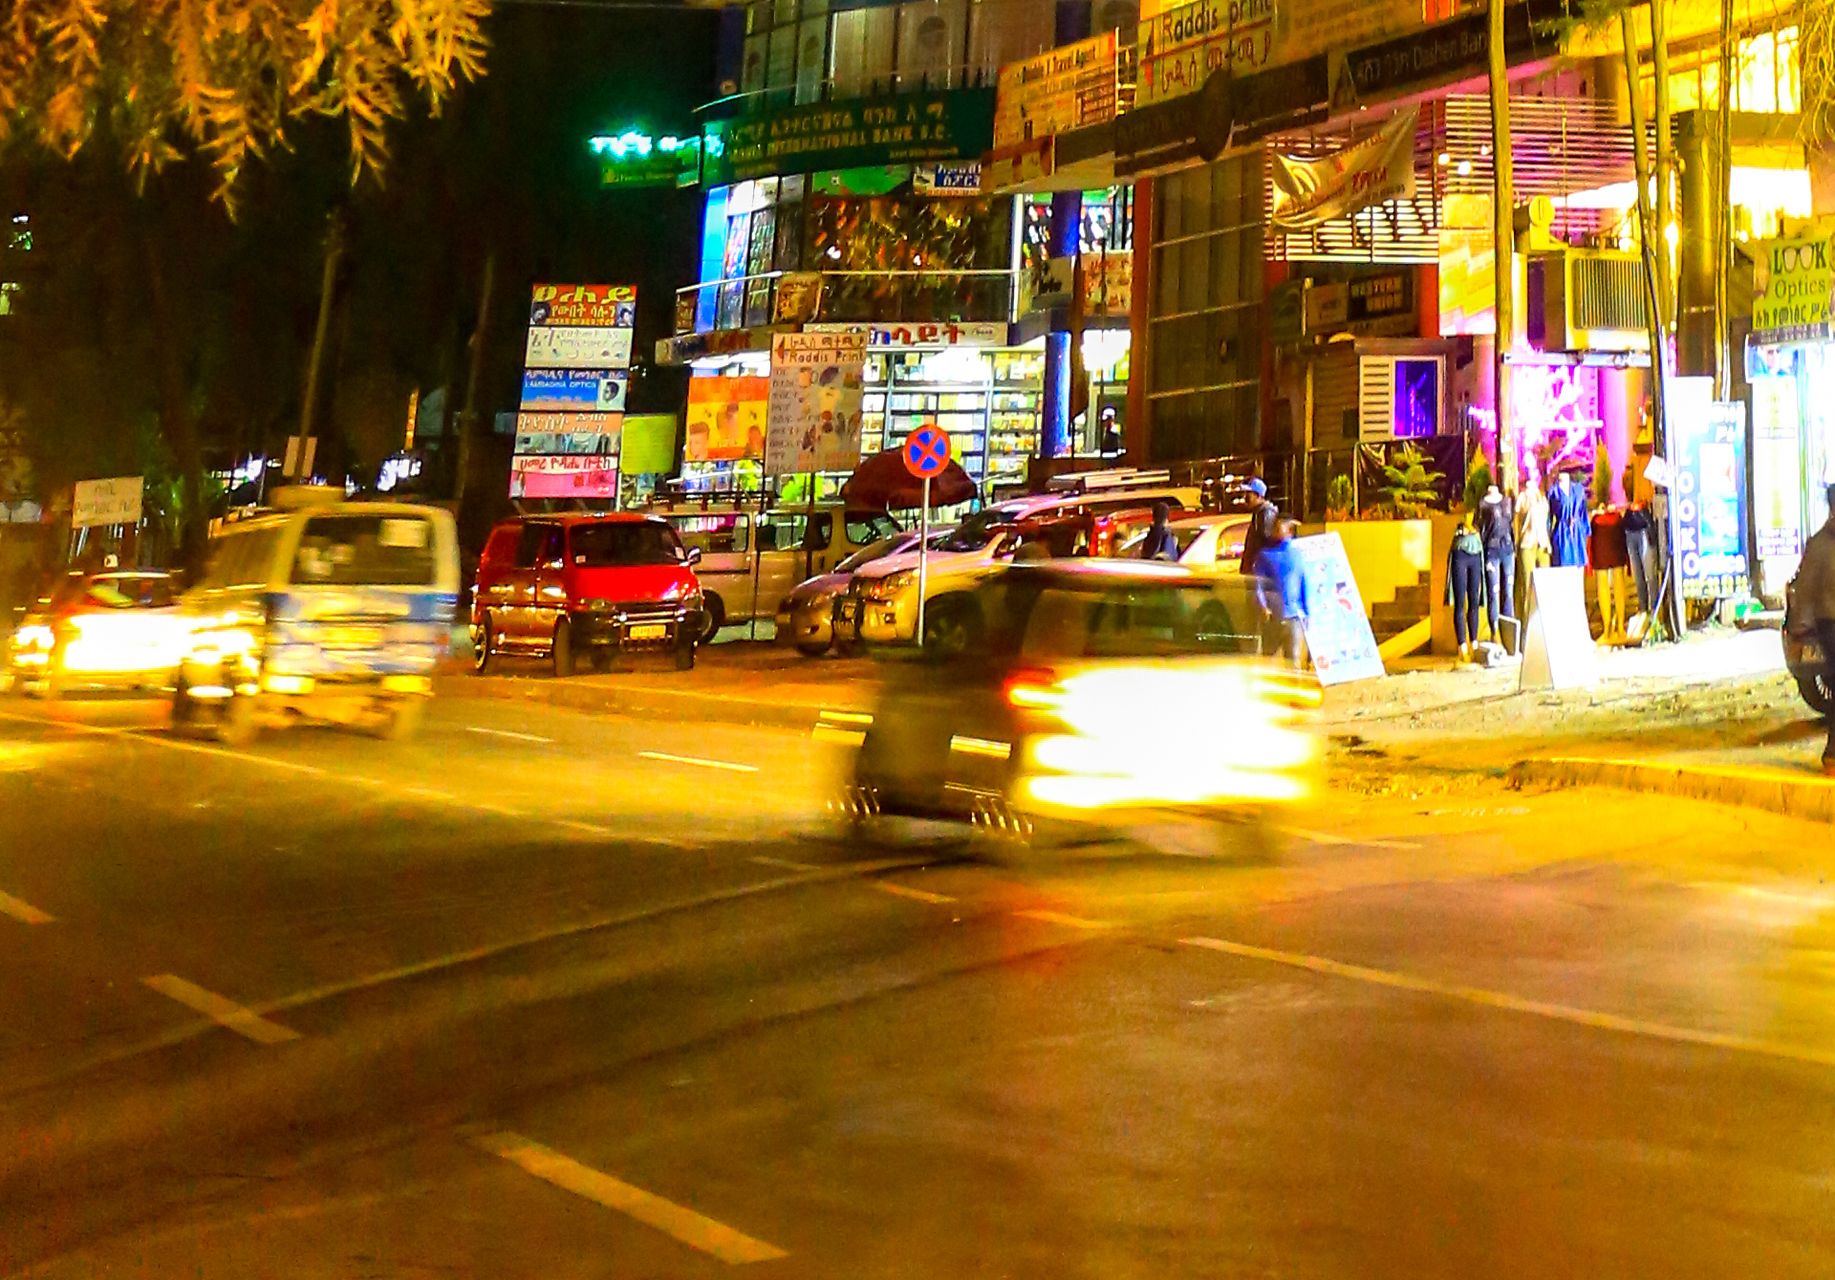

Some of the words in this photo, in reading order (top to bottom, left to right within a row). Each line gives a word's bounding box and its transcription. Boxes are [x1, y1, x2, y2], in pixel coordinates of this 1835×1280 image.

[1460, 31, 1489, 56] Ban
[1773, 241, 1826, 275] LOOK
[1774, 276, 1826, 304] Optics
[789, 350, 828, 363] Raddis
[835, 349, 864, 363] Print
